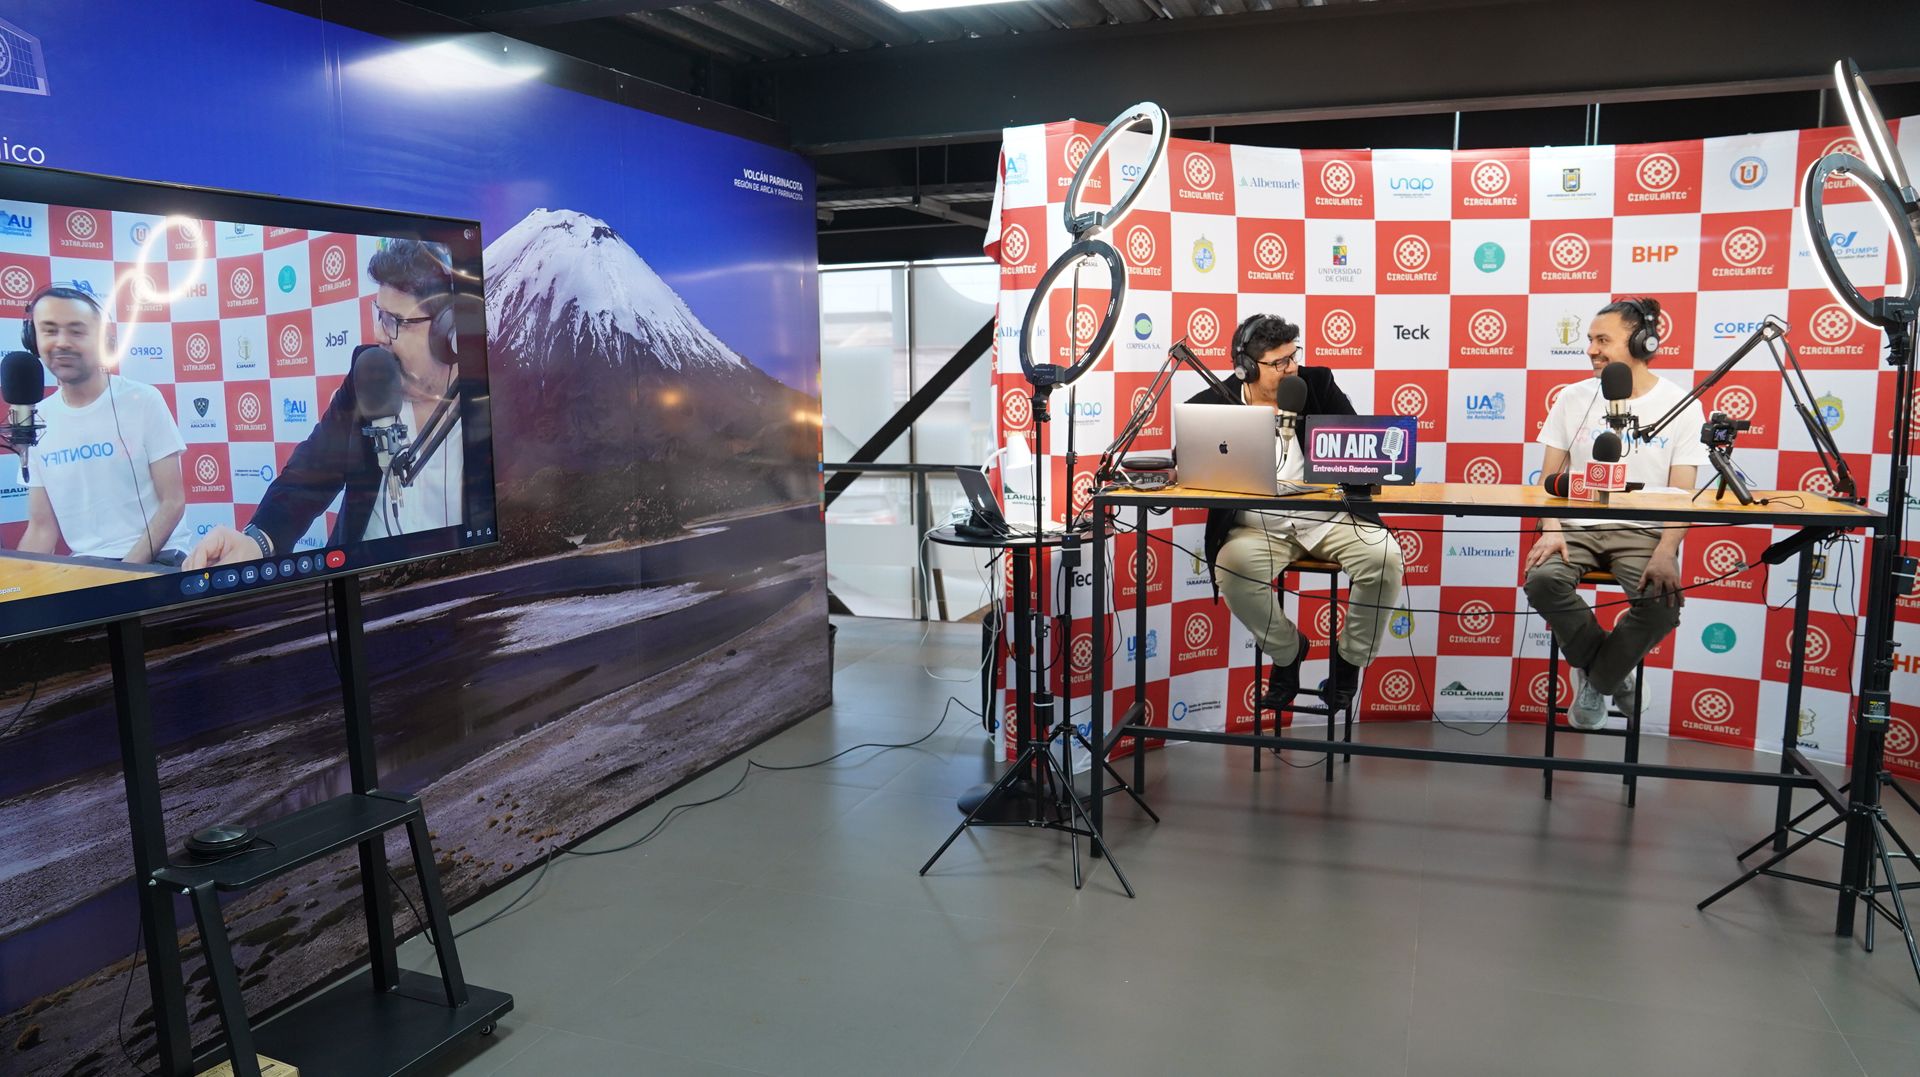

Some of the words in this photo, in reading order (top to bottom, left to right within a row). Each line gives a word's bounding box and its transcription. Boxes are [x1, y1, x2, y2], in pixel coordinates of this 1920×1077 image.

[2, 136, 46, 165] ico
[734, 178, 752, 190] REGIÓN
[752, 183, 760, 192] DE
[760, 185, 774, 195] ARICA
[743, 168, 768, 184] VOLCÁN
[769, 175, 804, 192] PARINACOTA
[1250, 177, 1300, 190] Albemarle
[1463, 196, 1517, 206] CIRCULARTEC
[1628, 191, 1688, 202] CIRCULARTEC
[1632, 245, 1679, 263] BHP
[1712, 267, 1773, 277] CIRCULARTEC
[1393, 325, 1430, 341] Teck
[1461, 346, 1513, 355] CIRCULARTEC
[1799, 346, 1863, 355] CIRCULARTEC
[1467, 395, 1493, 409] UA
[1316, 433, 1341, 458] ON
[1344, 433, 1377, 459] AIR
[1313, 465, 1347, 473] Entrevista
[1348, 465, 1378, 474] Random
[1459, 547, 1515, 557] Albemarle
[1071, 571, 1093, 587] Tec
